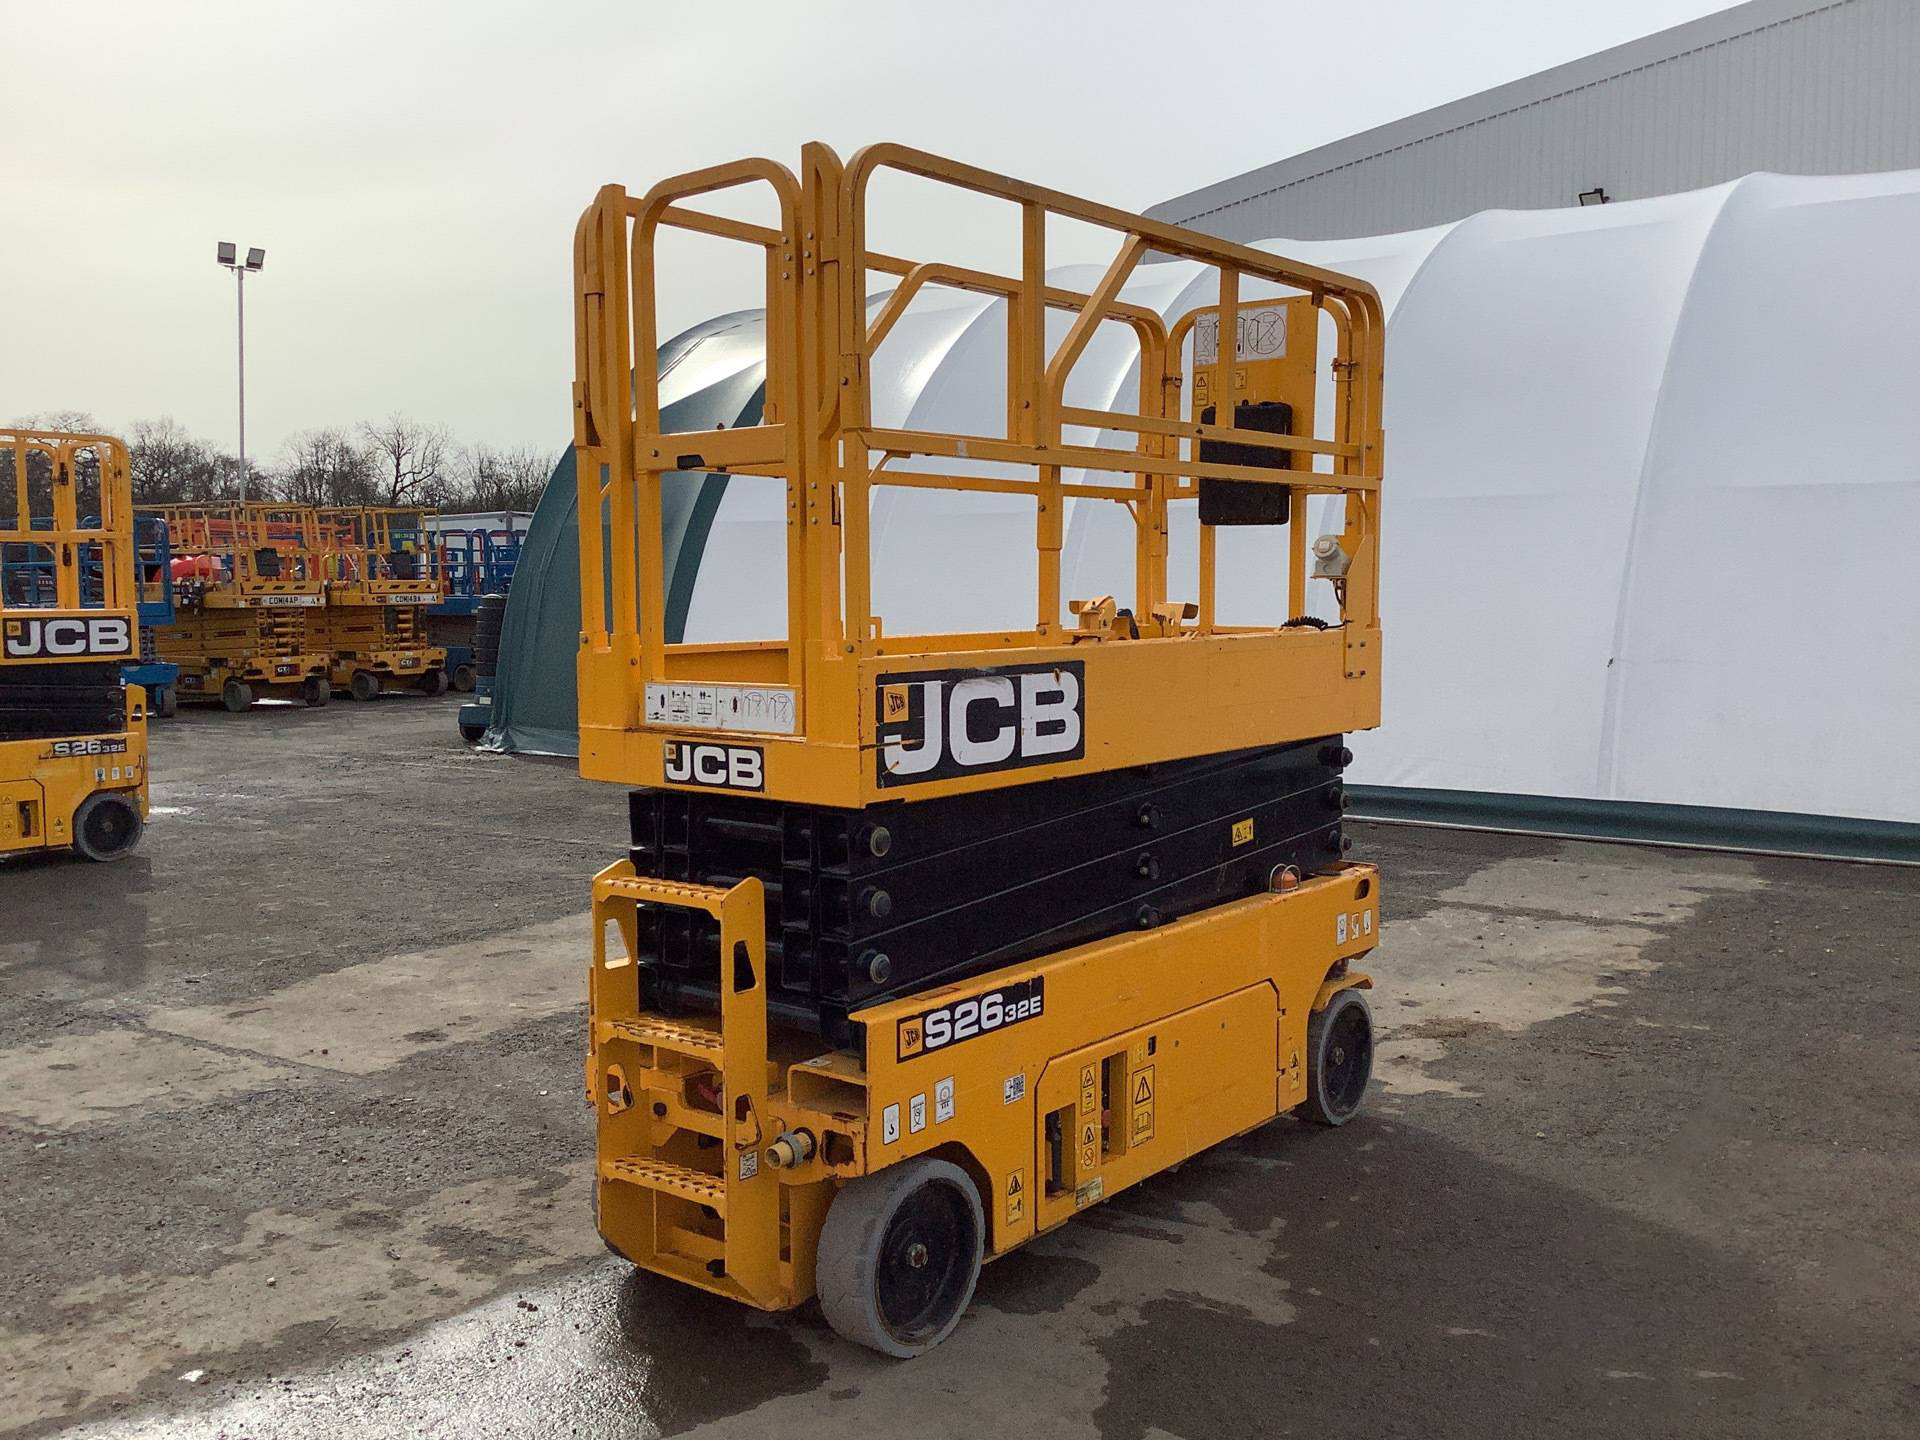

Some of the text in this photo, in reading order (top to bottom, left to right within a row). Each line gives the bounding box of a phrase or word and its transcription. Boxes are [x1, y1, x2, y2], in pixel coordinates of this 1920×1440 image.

[7, 620, 129, 655] JCB
[884, 671, 1081, 775] JCB
[665, 745, 763, 788] JCB
